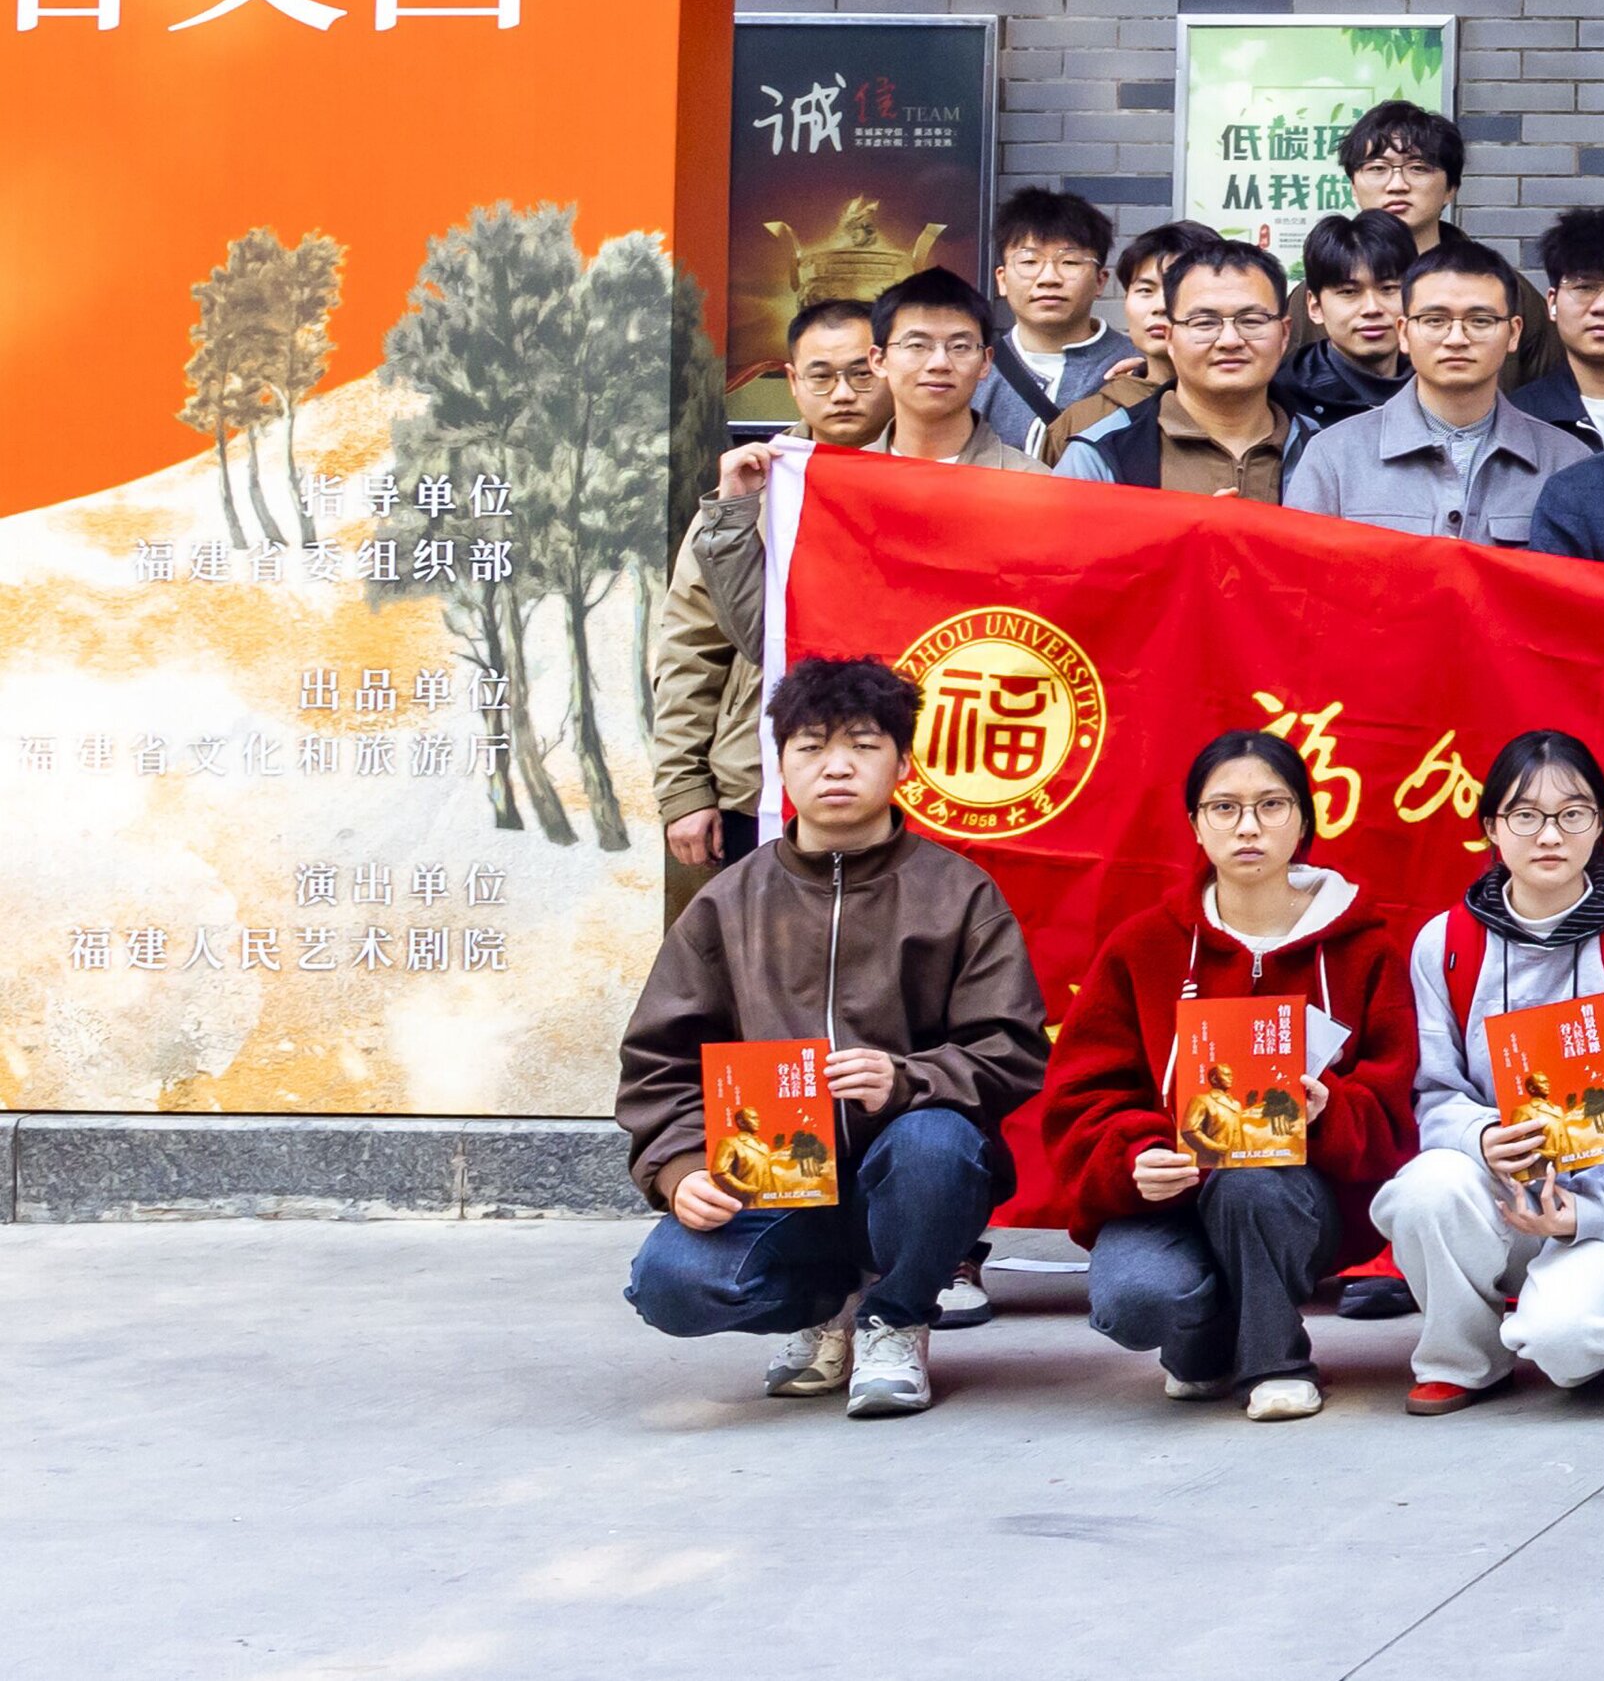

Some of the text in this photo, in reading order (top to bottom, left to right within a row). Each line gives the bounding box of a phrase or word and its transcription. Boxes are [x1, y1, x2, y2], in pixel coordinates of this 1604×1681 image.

[902, 106, 961, 122] TEAM
[300, 473, 514, 520] 指导单位
[134, 538, 514, 583] 福建省委组织部
[300, 668, 512, 712] 出品单位
[901, 614, 1099, 730] ZHOU UNIVERSITY
[18, 731, 510, 777] 福建省文化和旅游厅
[962, 813, 997, 827] 1958
[295, 861, 508, 907] 演出单位
[70, 927, 510, 972] 福建人民艺术剧院
